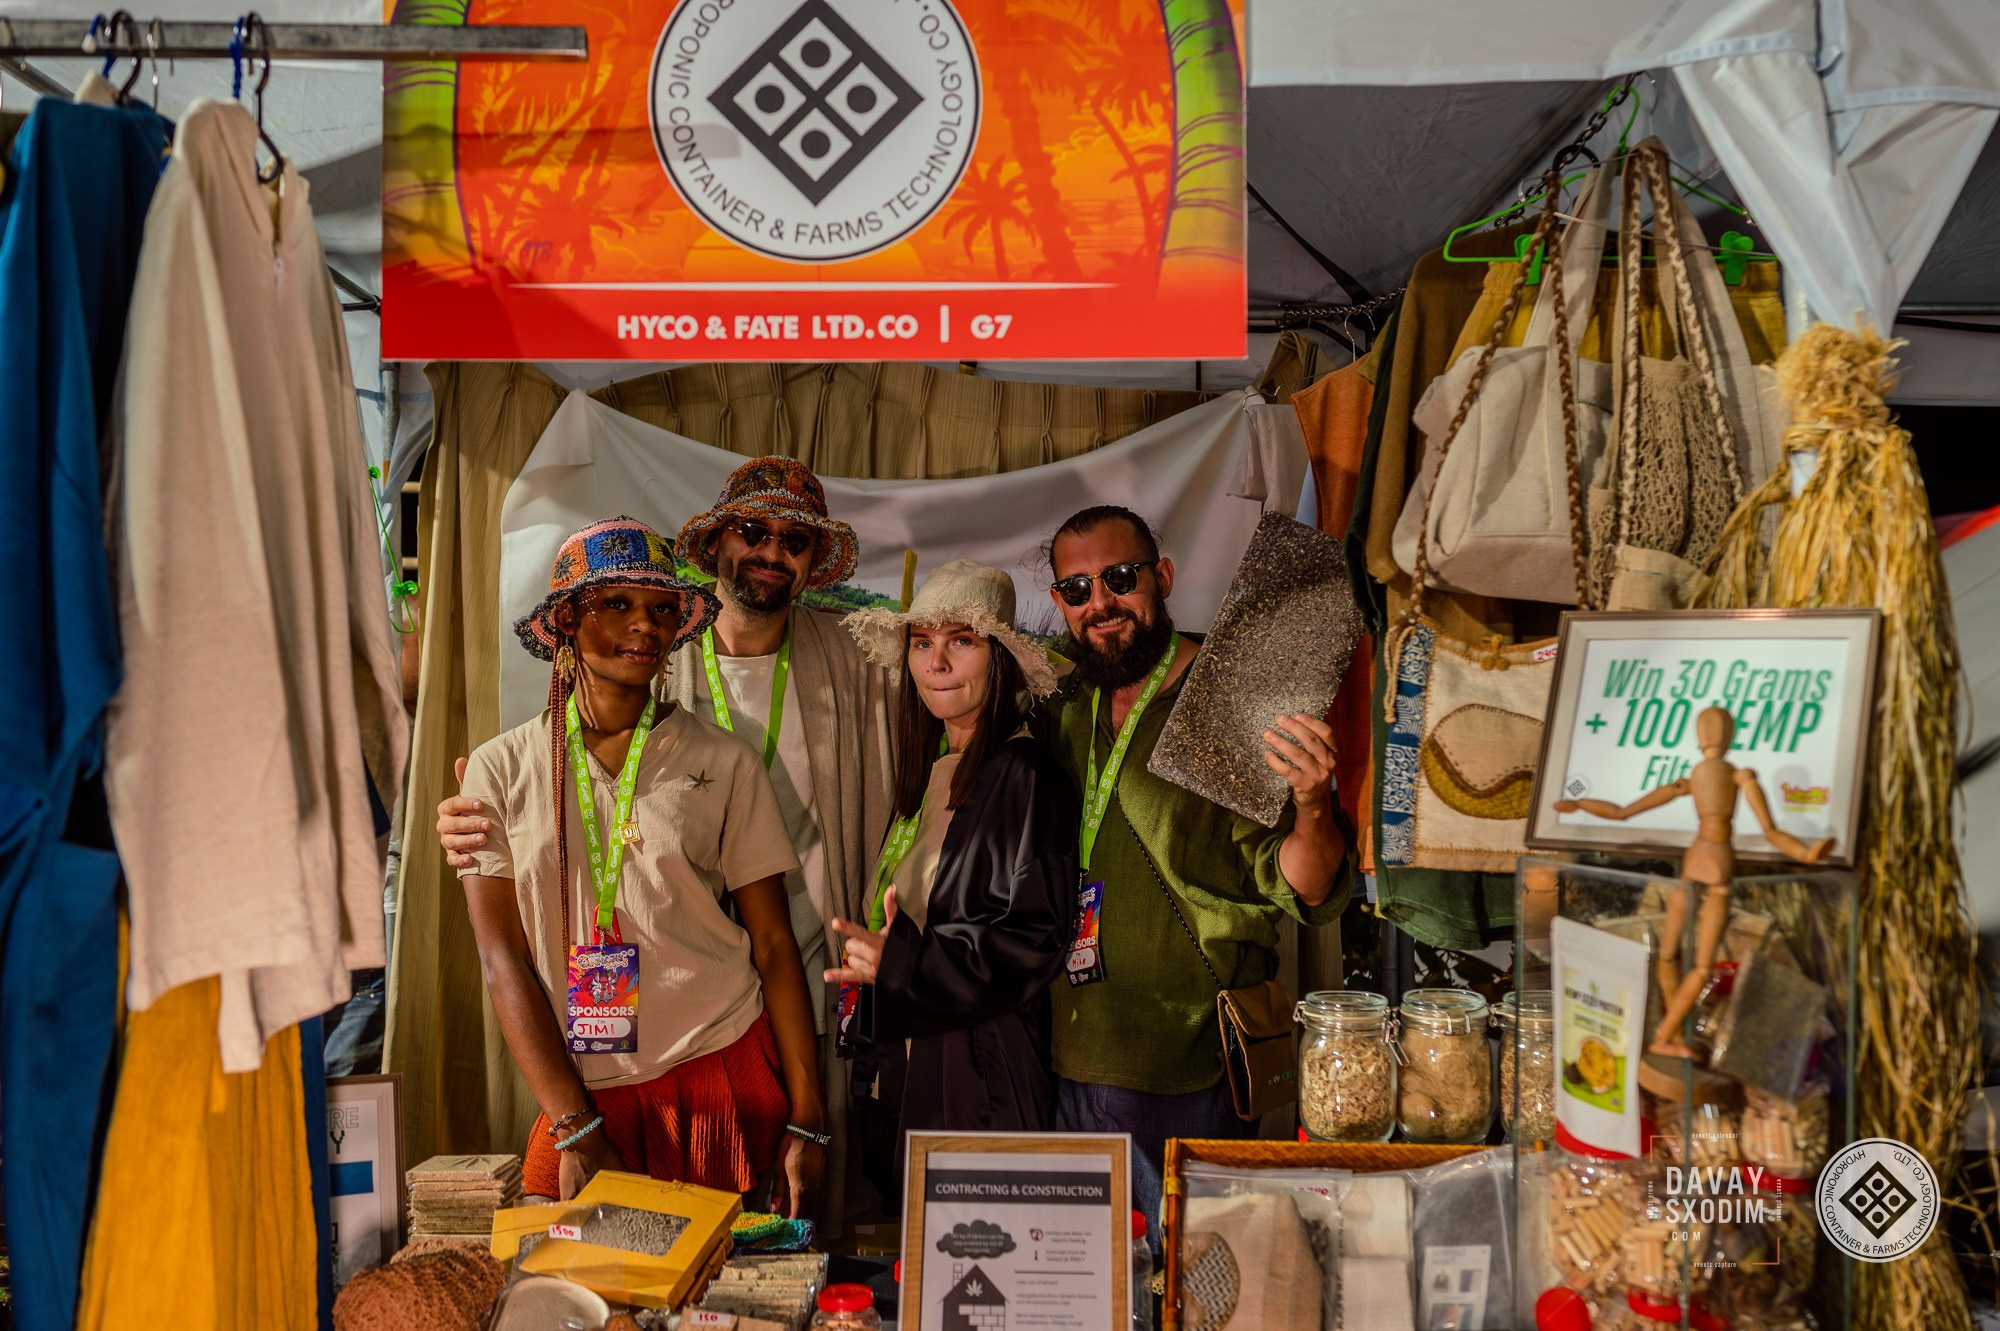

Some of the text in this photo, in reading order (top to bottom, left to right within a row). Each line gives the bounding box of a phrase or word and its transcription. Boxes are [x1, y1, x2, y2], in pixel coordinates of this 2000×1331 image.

[669, 106, 765, 233] CONTAINER
[769, 218, 785, 241] &
[794, 210, 883, 245] FARMS
[882, 58, 963, 219] TECHNOLOGY
[617, 314, 1013, 340] HYCO & FATE LTD.CO G7
[1603, 659, 1834, 702] Win 30 Grams
[1585, 699, 1822, 753] + 100 EMP
[569, 1006, 635, 1017] SPONSORS
[577, 1023, 615, 1036] JIMI
[327, 1108, 359, 1129] RE
[935, 1183, 1103, 1198] CONTRACTING & CONSTRUCTION
